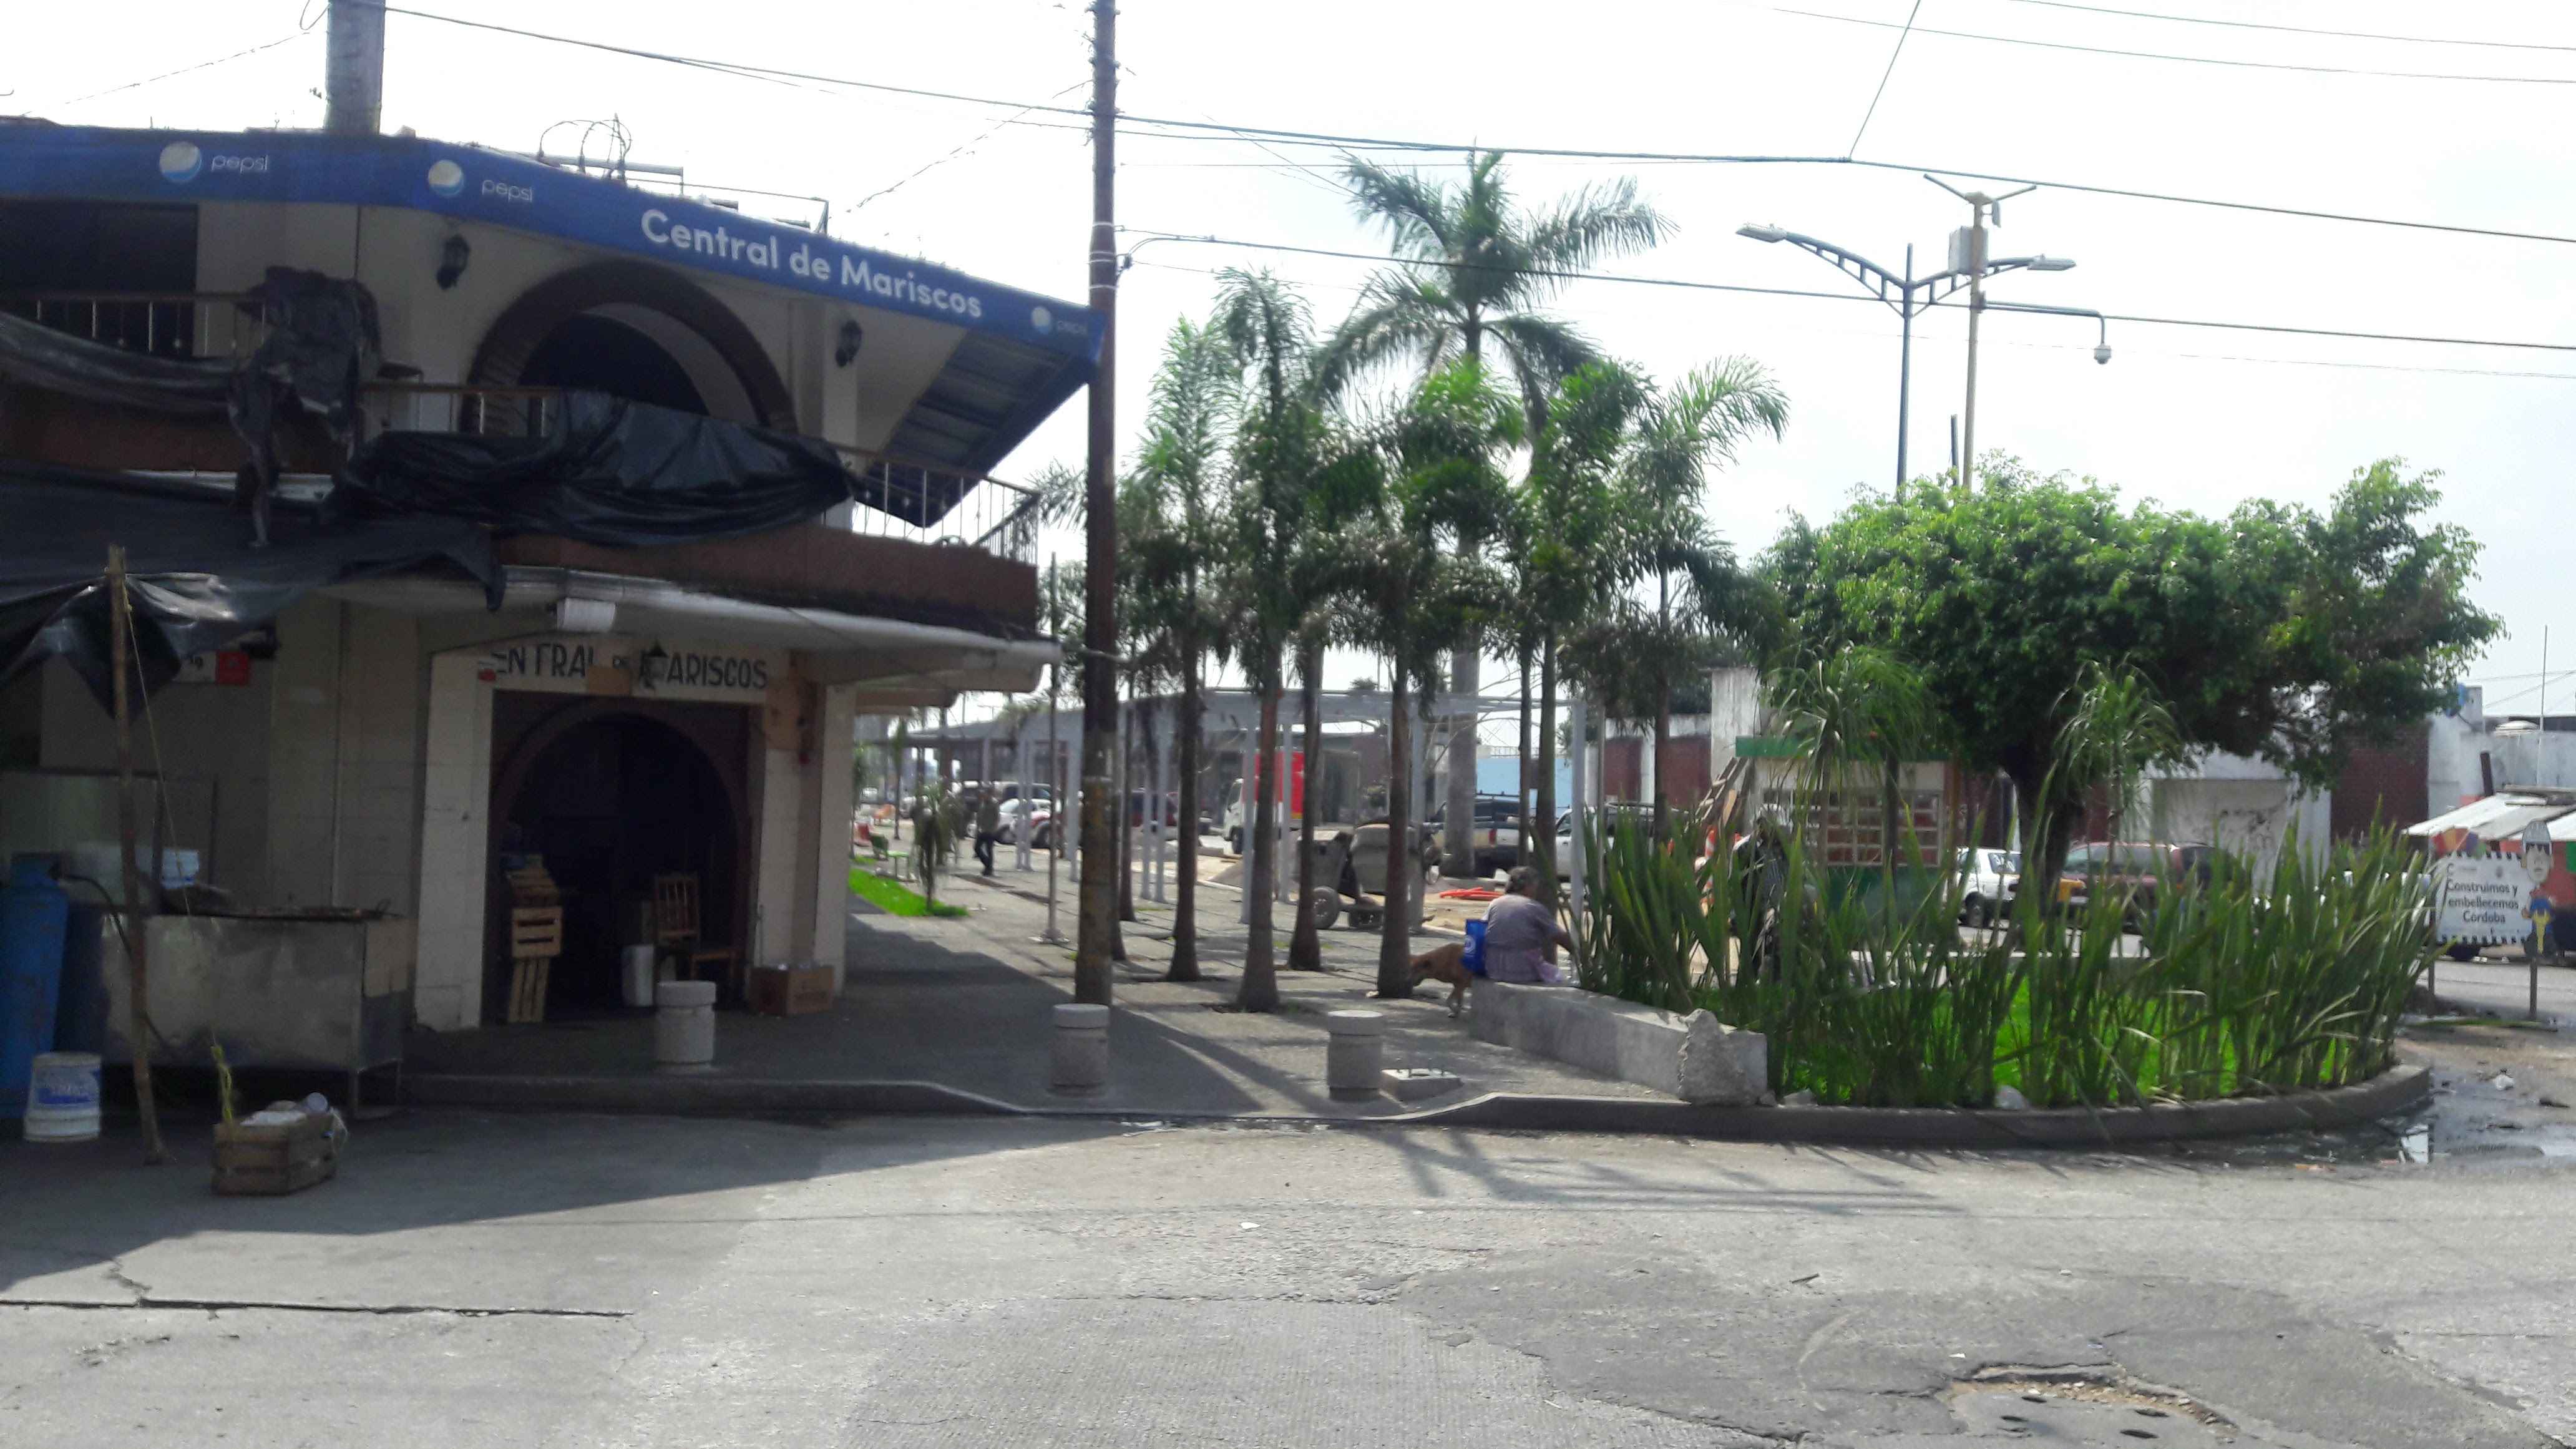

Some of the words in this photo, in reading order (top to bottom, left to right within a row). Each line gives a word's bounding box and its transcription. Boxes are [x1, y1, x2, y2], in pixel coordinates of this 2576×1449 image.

[211, 154, 269, 174] pepsi
[482, 179, 533, 202] pepsi
[640, 208, 778, 270] Central
[789, 243, 831, 280] de
[841, 254, 982, 318] Mariscos
[2446, 879, 2510, 894] Construimos
[2512, 885, 2518, 897] y
[2448, 895, 2519, 909] embellecemos
